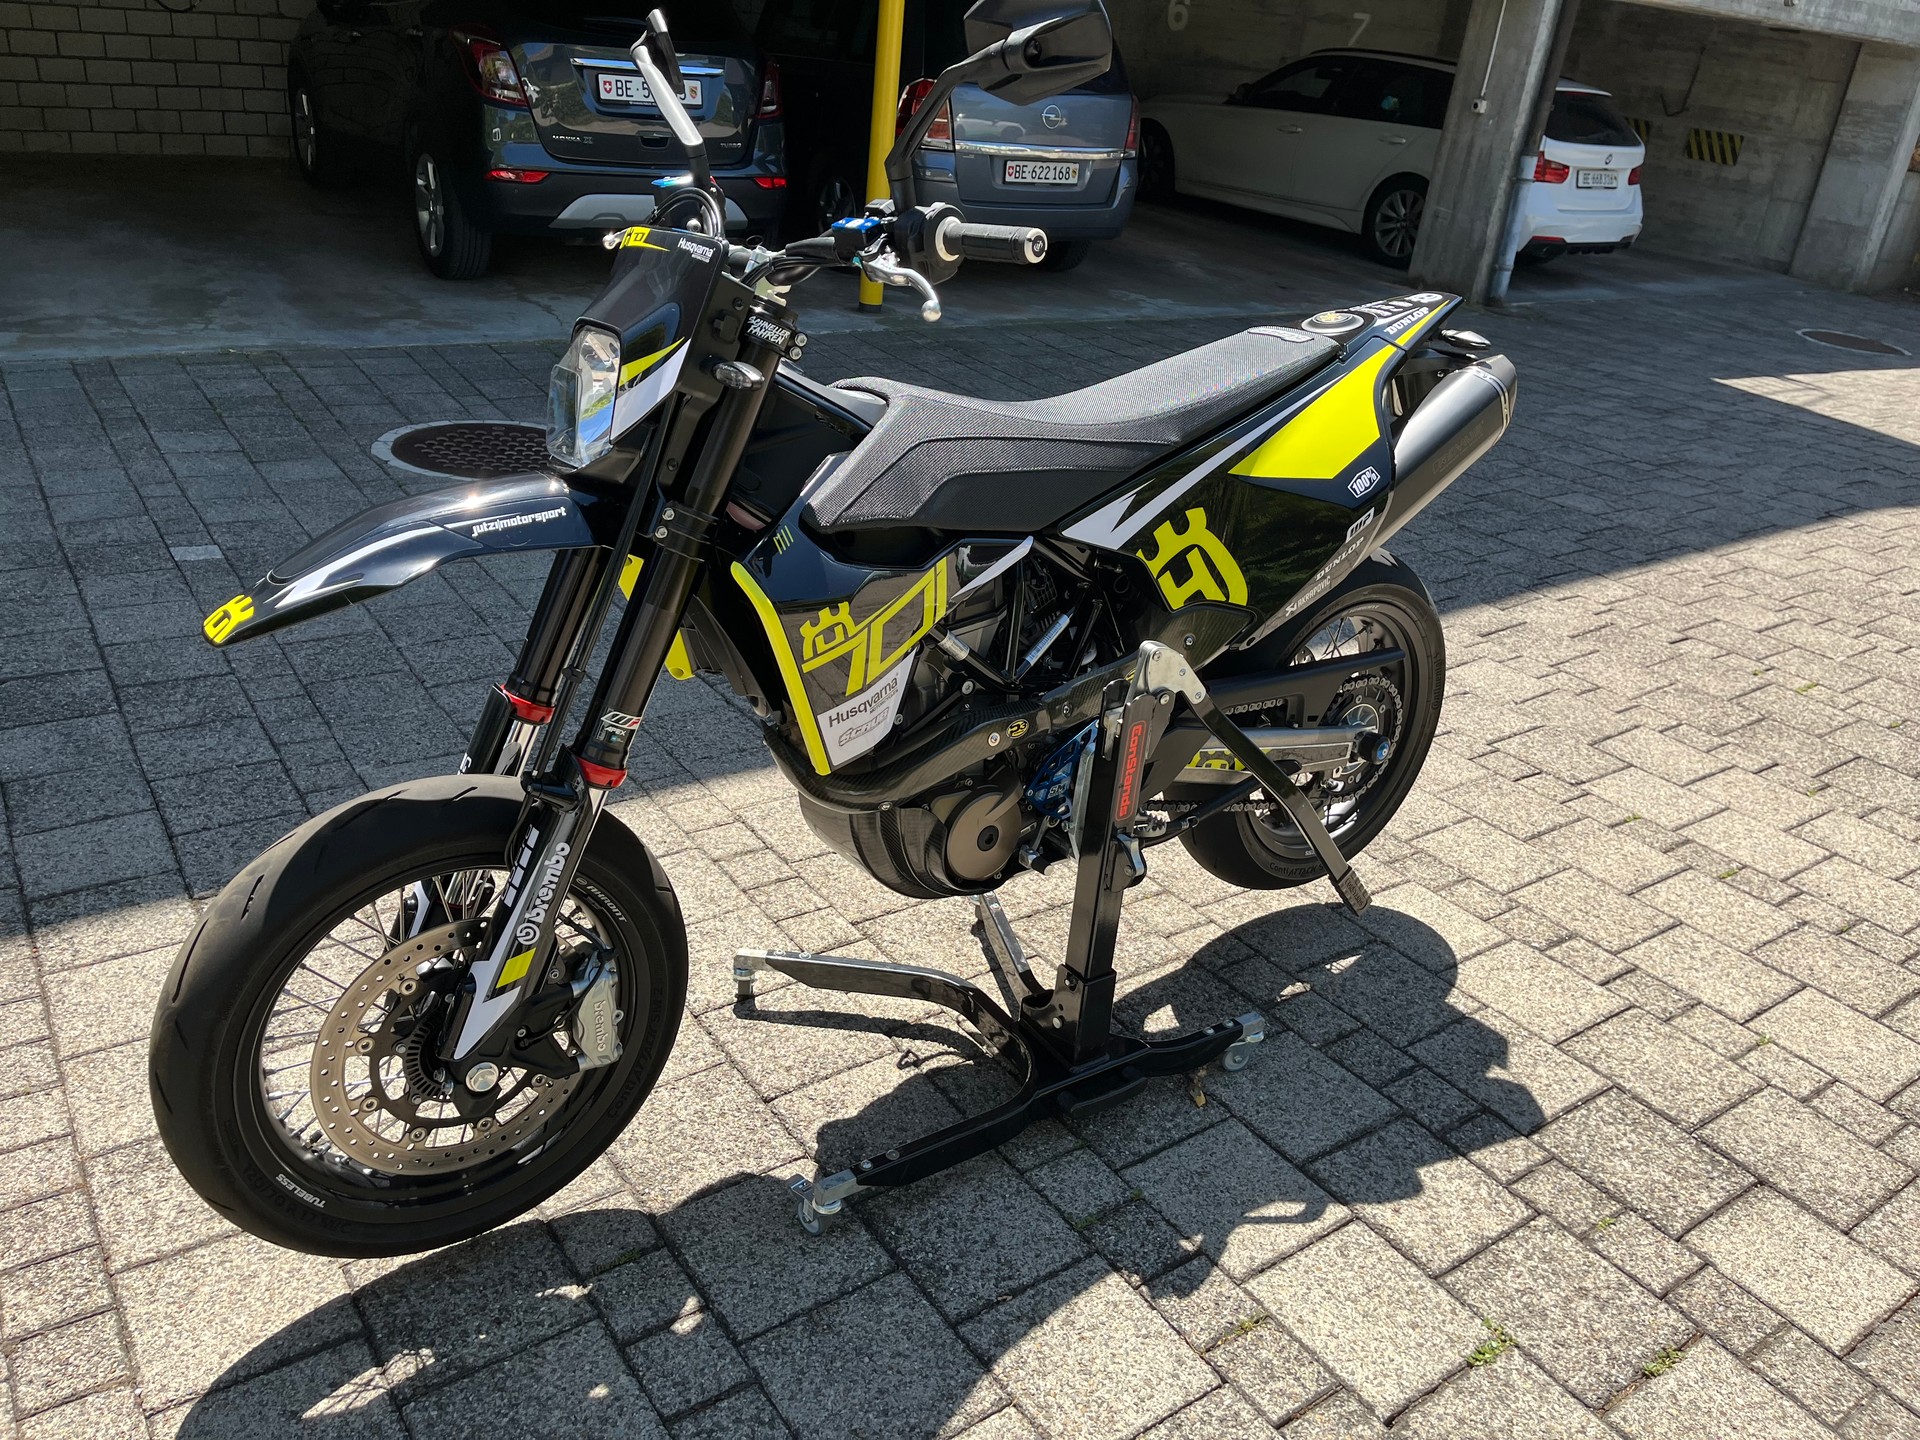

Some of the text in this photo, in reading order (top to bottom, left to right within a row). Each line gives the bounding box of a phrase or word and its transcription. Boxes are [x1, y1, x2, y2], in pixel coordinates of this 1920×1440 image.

[1348, 12, 1371, 47] 7
[678, 238, 714, 257] Husqvarna
[747, 316, 791, 338] SCHNELLER
[747, 325, 785, 345] FAHREN
[1384, 307, 1429, 335] DUNLOP
[1352, 469, 1378, 495] 100%
[1315, 536, 1364, 581] DUNLOP
[828, 678, 898, 728] Husqvarna
[605, 727, 626, 736] APEX
[524, 842, 570, 923] brembo
[594, 1000, 609, 1052] brembo
[276, 1173, 326, 1208] TUBELESS
